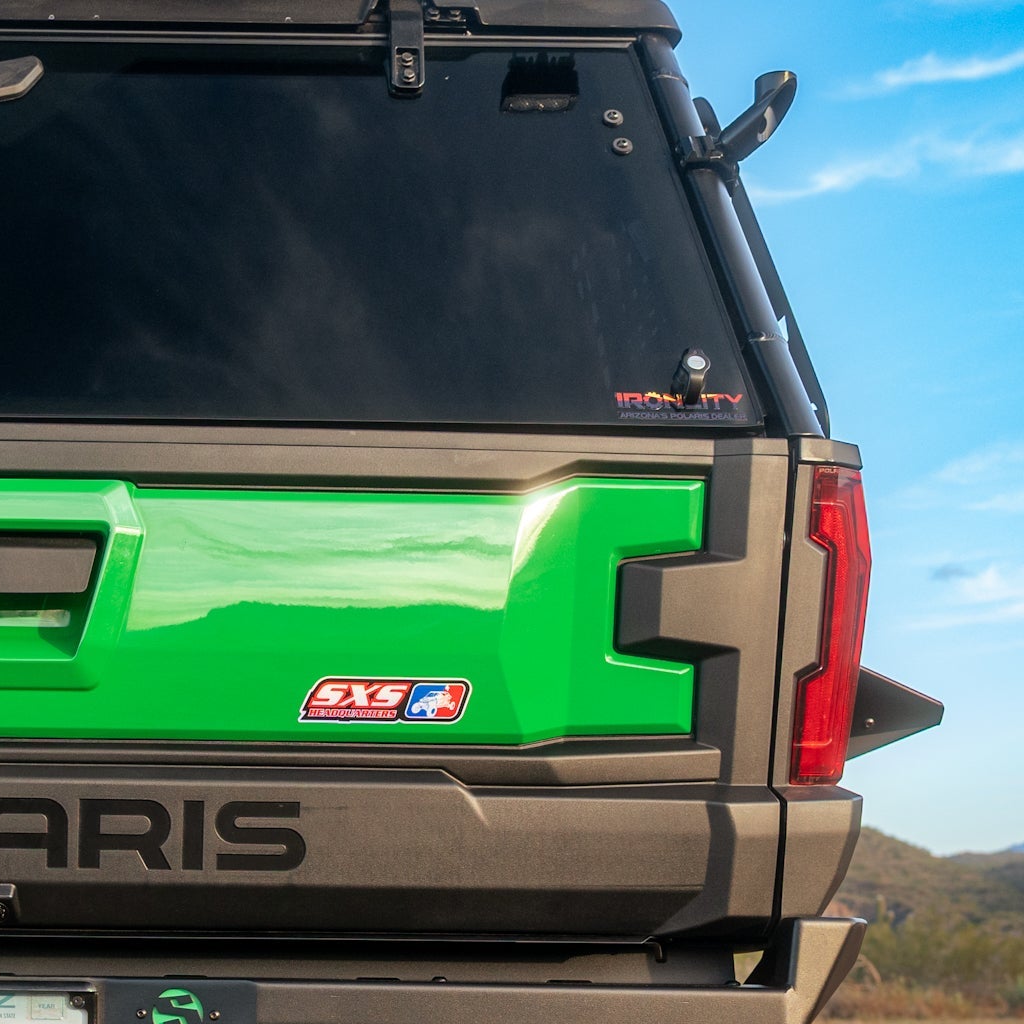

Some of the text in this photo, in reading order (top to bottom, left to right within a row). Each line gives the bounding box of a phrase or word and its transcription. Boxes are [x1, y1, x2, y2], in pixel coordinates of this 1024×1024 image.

[711, 413, 747, 421] DEALER
[311, 683, 409, 707] SXS
[308, 709, 397, 718] HEADQUARTERS
